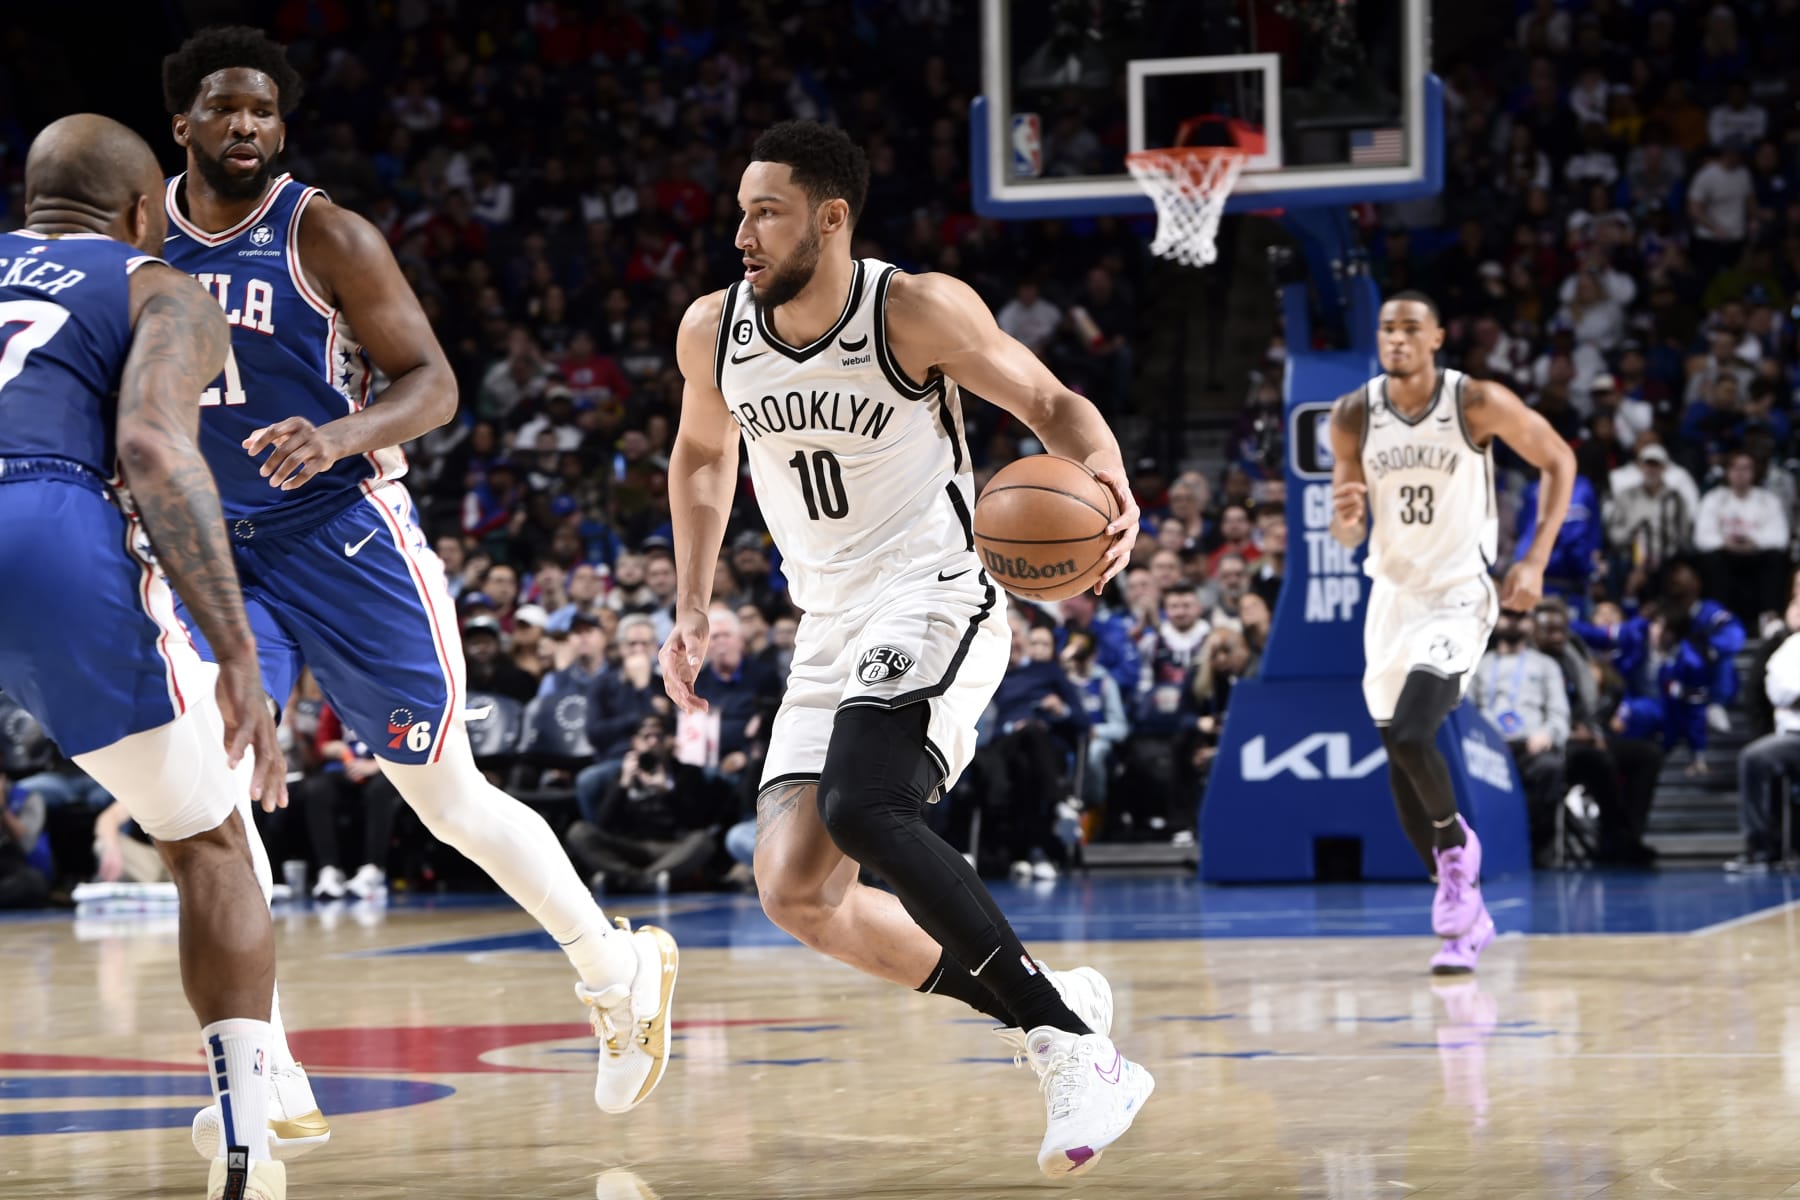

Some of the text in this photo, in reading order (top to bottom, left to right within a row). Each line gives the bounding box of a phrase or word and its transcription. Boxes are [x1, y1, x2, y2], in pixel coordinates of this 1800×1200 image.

[738, 322, 751, 343] 6
[841, 355, 871, 367] Webull
[1368, 444, 1459, 480] BROOKLYN
[789, 450, 849, 520] 10
[1400, 484, 1435, 525] 33
[982, 547, 1077, 579] Wilson
[1305, 577, 1361, 621] APP
[860, 647, 909, 671] NETS
[868, 664, 882, 679] B
[387, 721, 431, 752] 76
